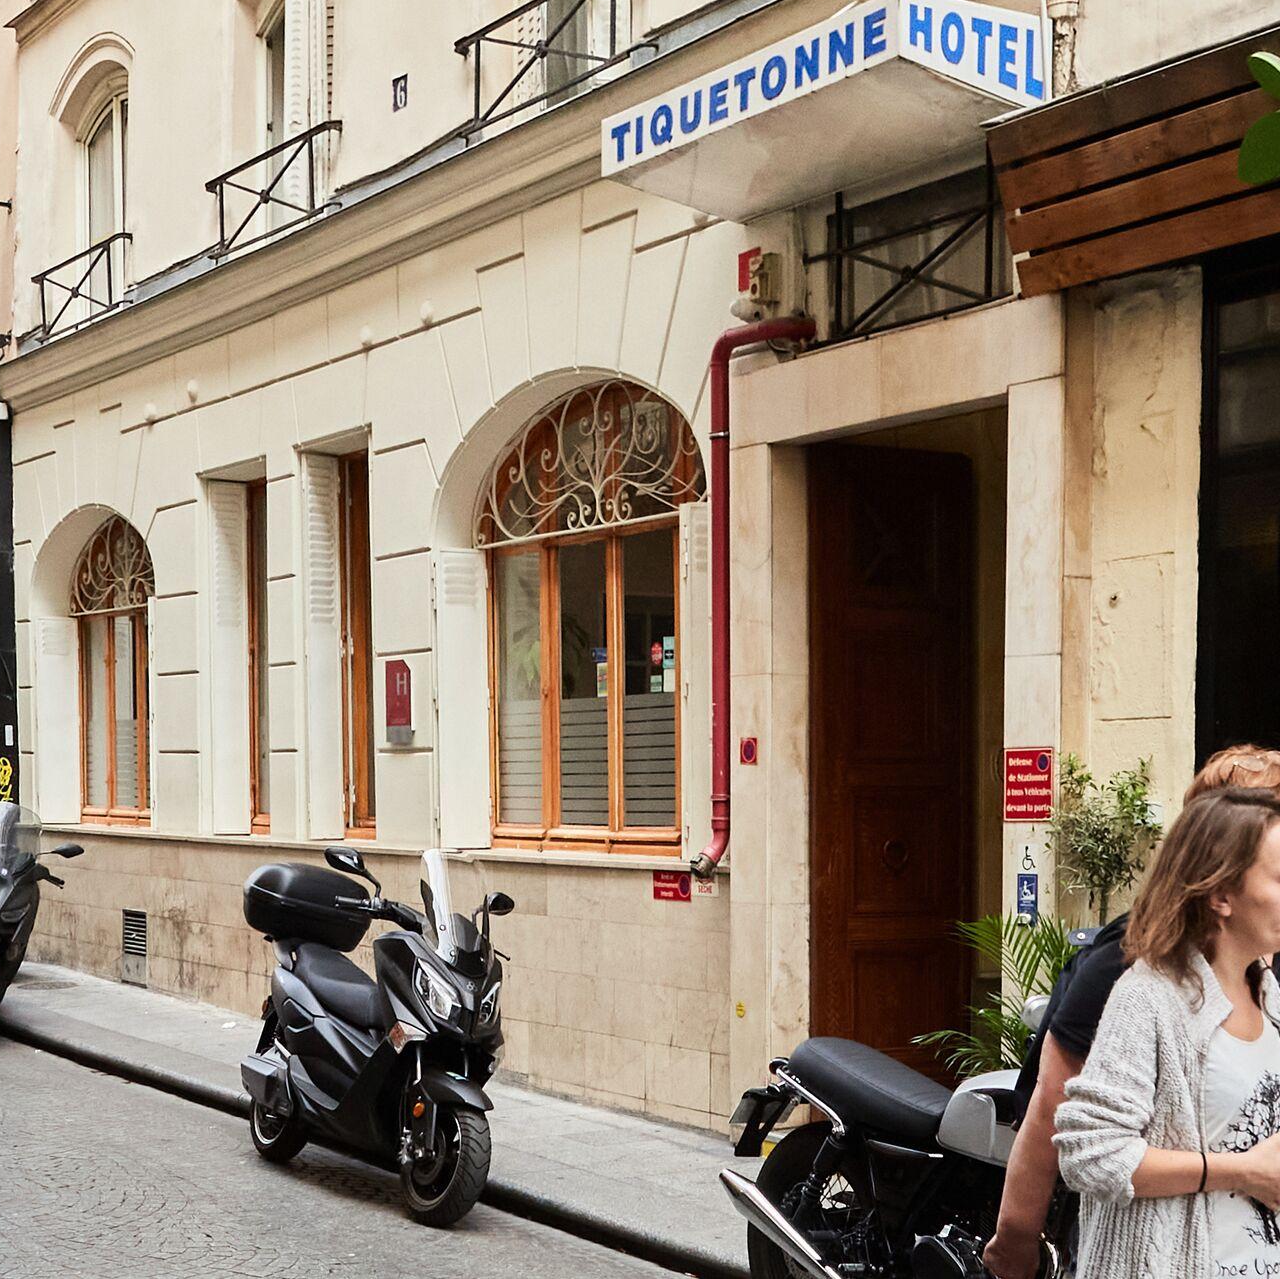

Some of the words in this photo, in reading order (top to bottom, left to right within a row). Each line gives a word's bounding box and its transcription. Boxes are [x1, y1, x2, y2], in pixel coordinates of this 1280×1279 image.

[396, 79, 406, 109] 6
[611, 7, 887, 163] TIQUETONNE
[909, 3, 1044, 100] HOTEL
[395, 672, 407, 696] H
